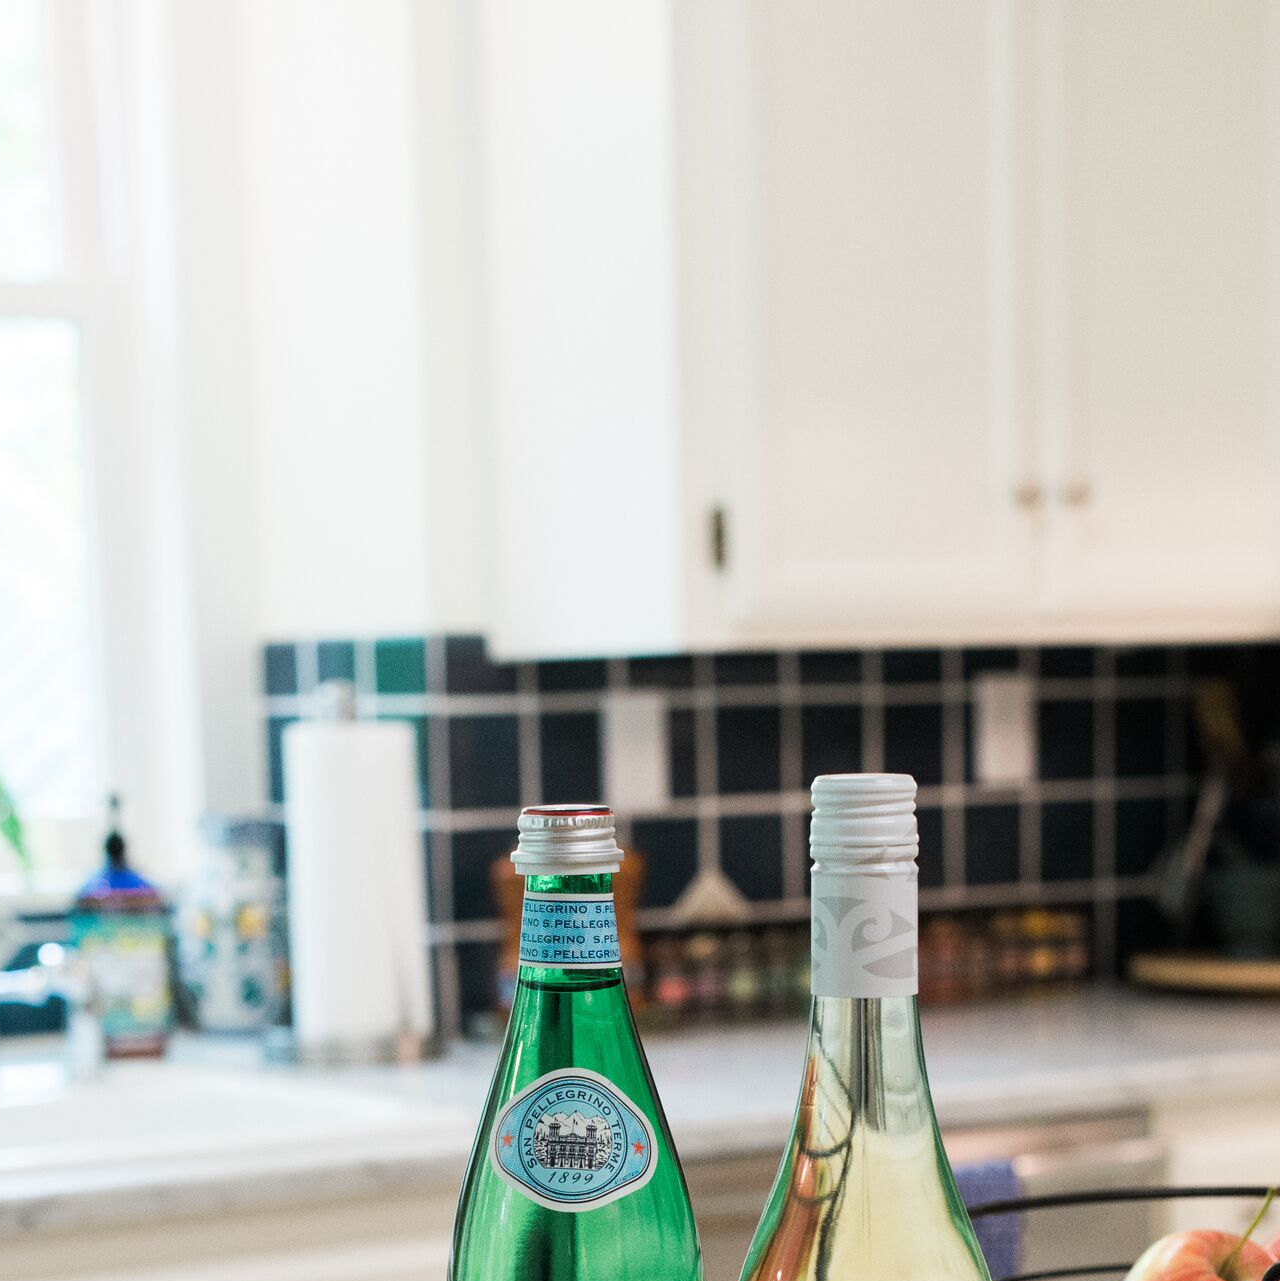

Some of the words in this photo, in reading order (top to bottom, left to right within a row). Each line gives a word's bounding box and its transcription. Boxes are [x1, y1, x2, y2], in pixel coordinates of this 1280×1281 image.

[525, 1089, 612, 1130] PELLEGRINO
[523, 1137, 538, 1169] SAN
[604, 1119, 622, 1173] TERME
[547, 1171, 594, 1185] 1899
